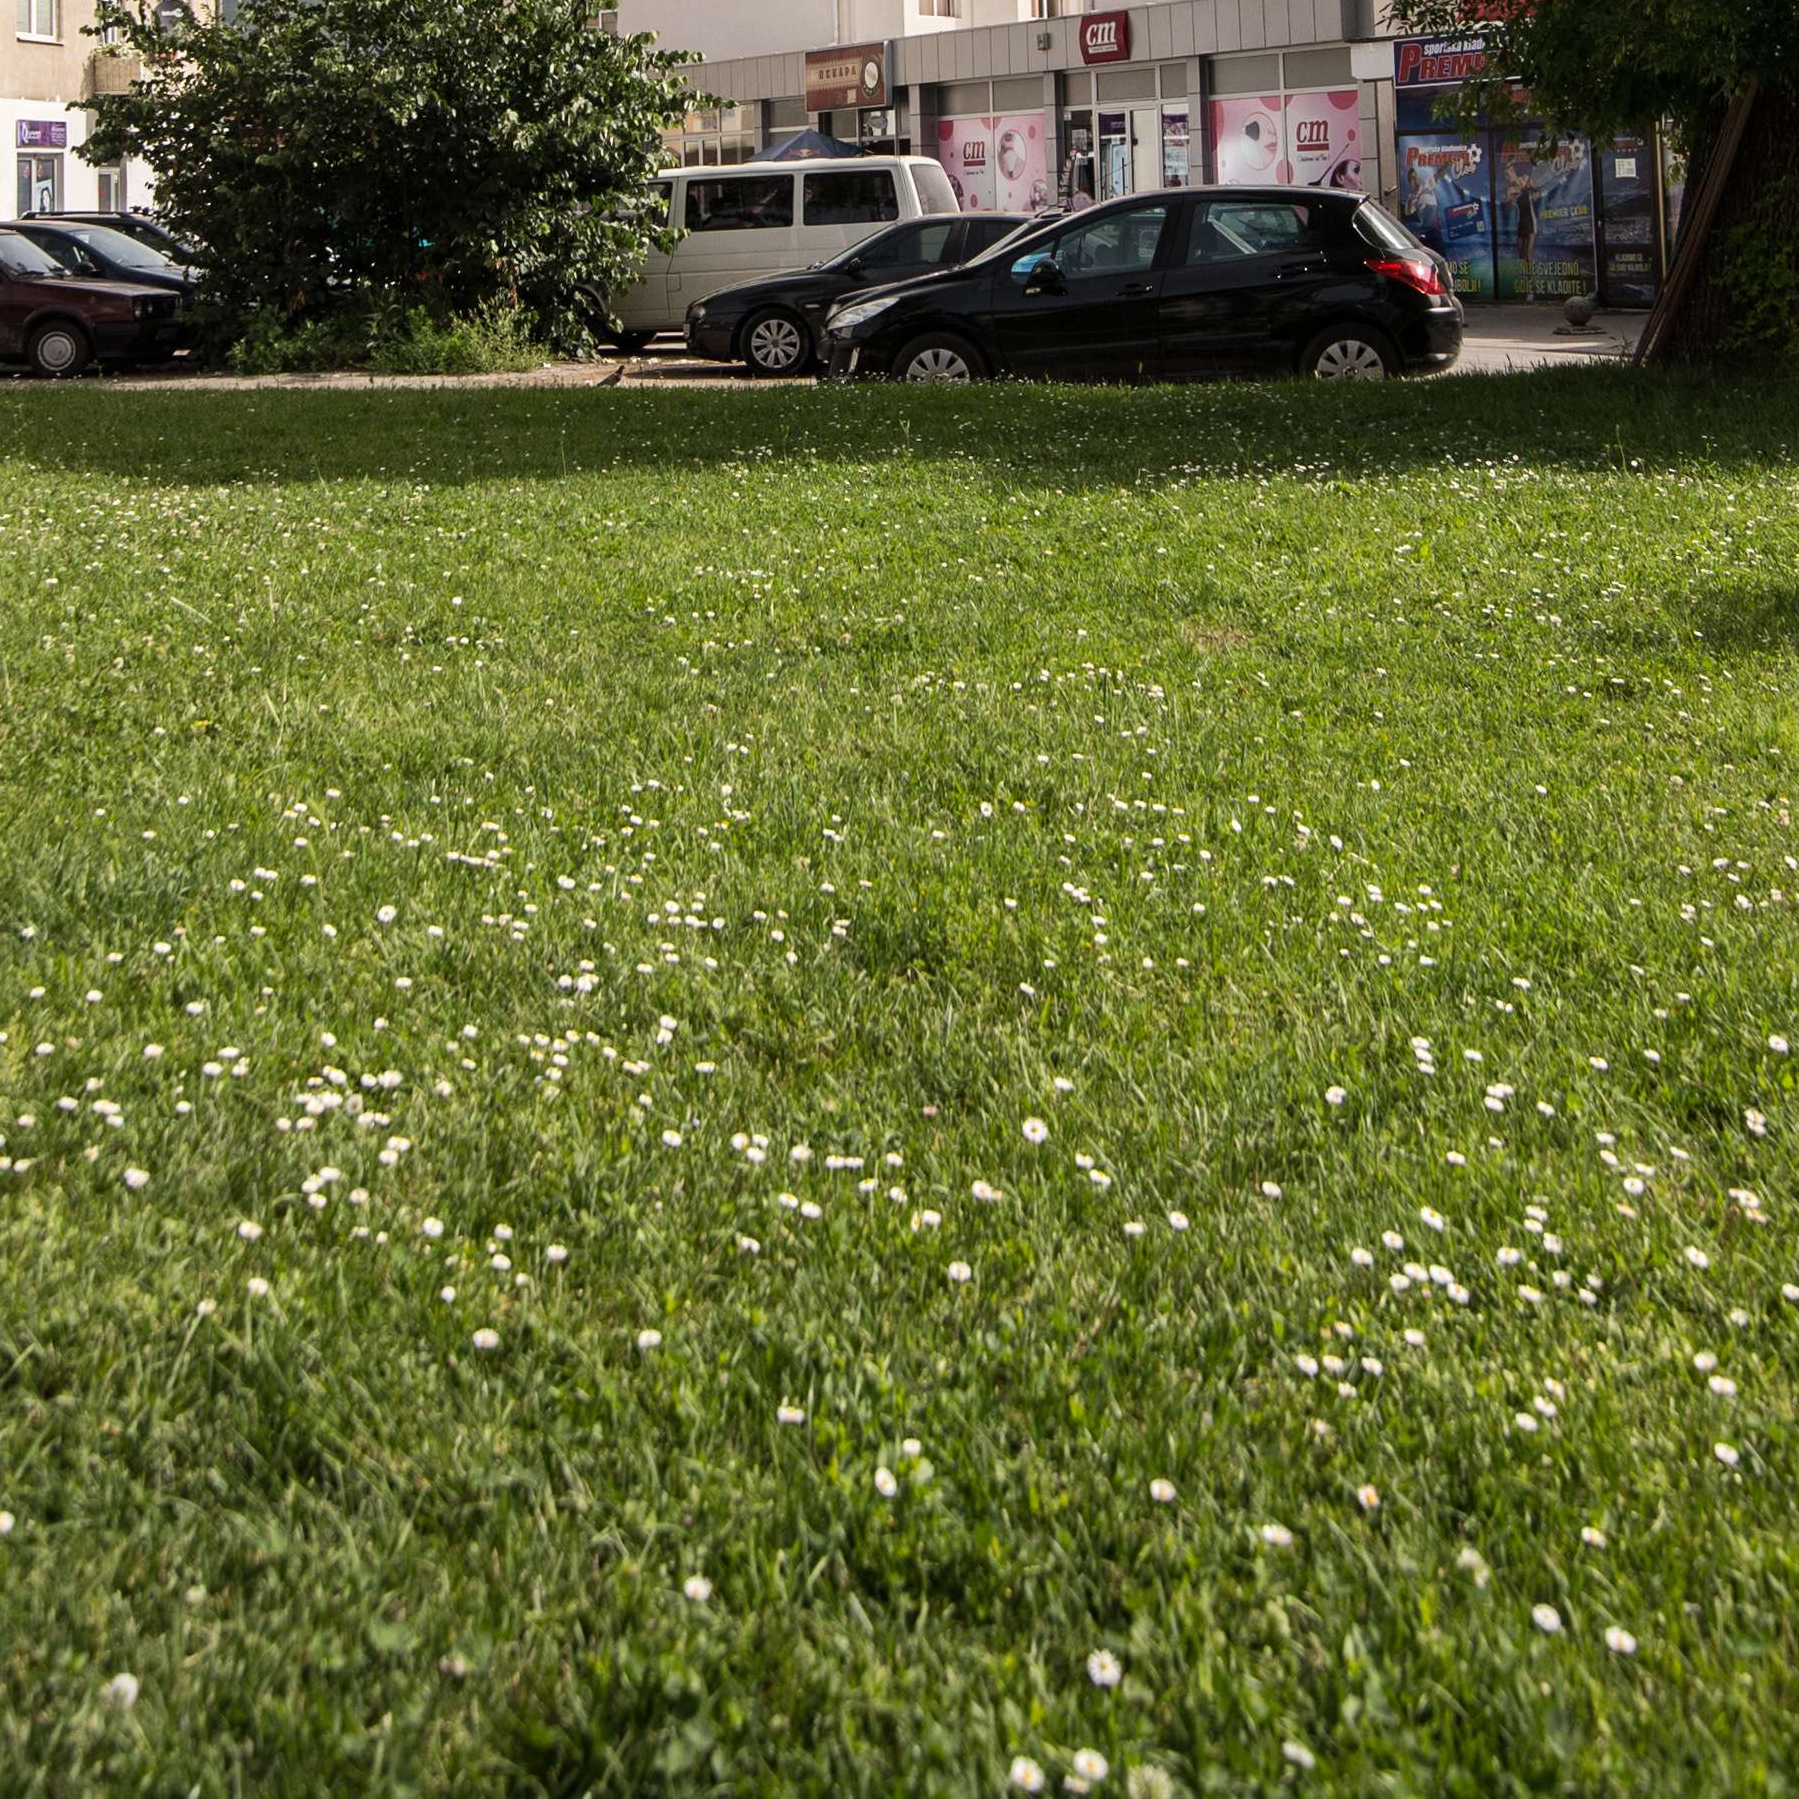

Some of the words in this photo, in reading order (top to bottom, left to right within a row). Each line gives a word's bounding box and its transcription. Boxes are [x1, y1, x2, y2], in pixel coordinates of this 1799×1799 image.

[1086, 21, 1117, 46] cm
[1296, 120, 1329, 143] cm
[963, 140, 985, 159] cm
